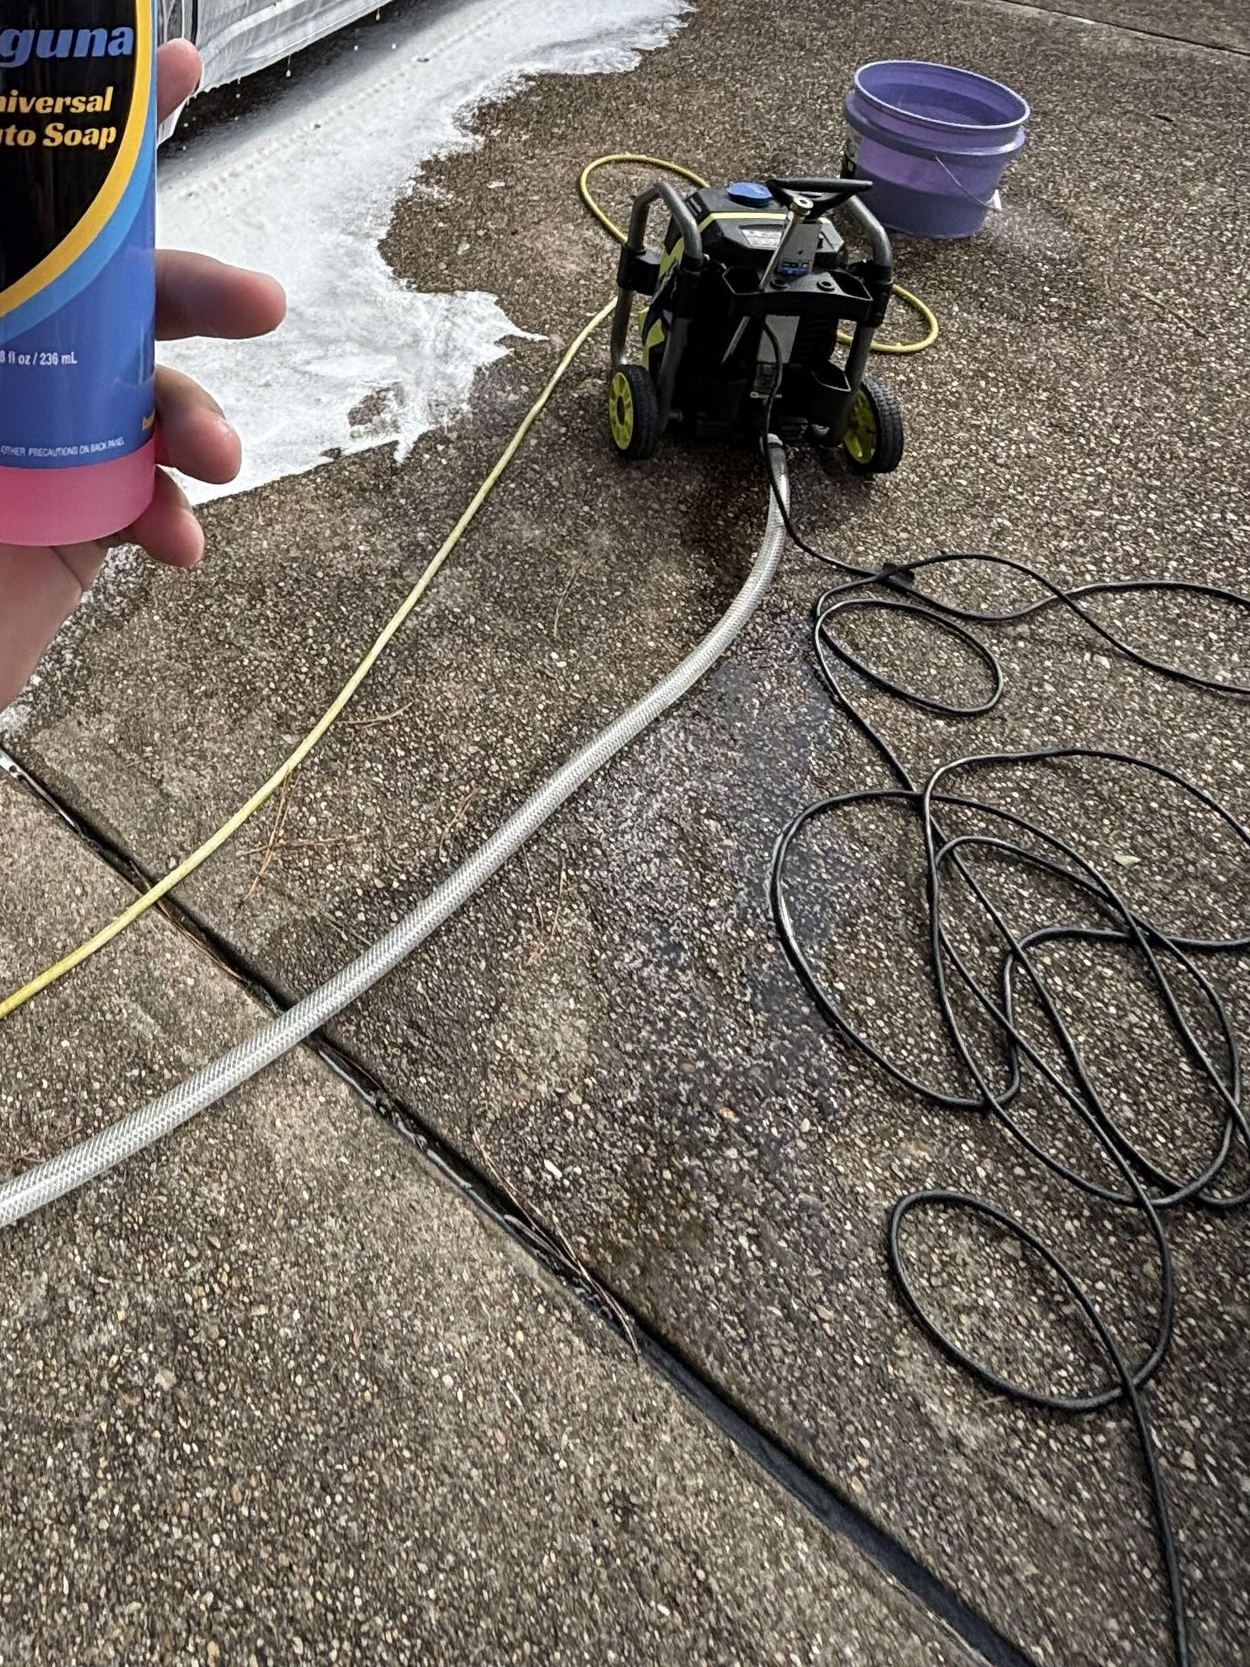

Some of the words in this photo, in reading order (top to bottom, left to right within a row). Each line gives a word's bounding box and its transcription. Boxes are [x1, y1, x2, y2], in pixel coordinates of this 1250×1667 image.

[42, 122, 117, 150] Soap
[8, 350, 16, 365] fl
[18, 354, 31, 366] oz
[32, 352, 38, 366] /
[39, 352, 59, 366] 236
[61, 351, 78, 365] mL
[28, 445, 79, 457] PRECAUTIONS
